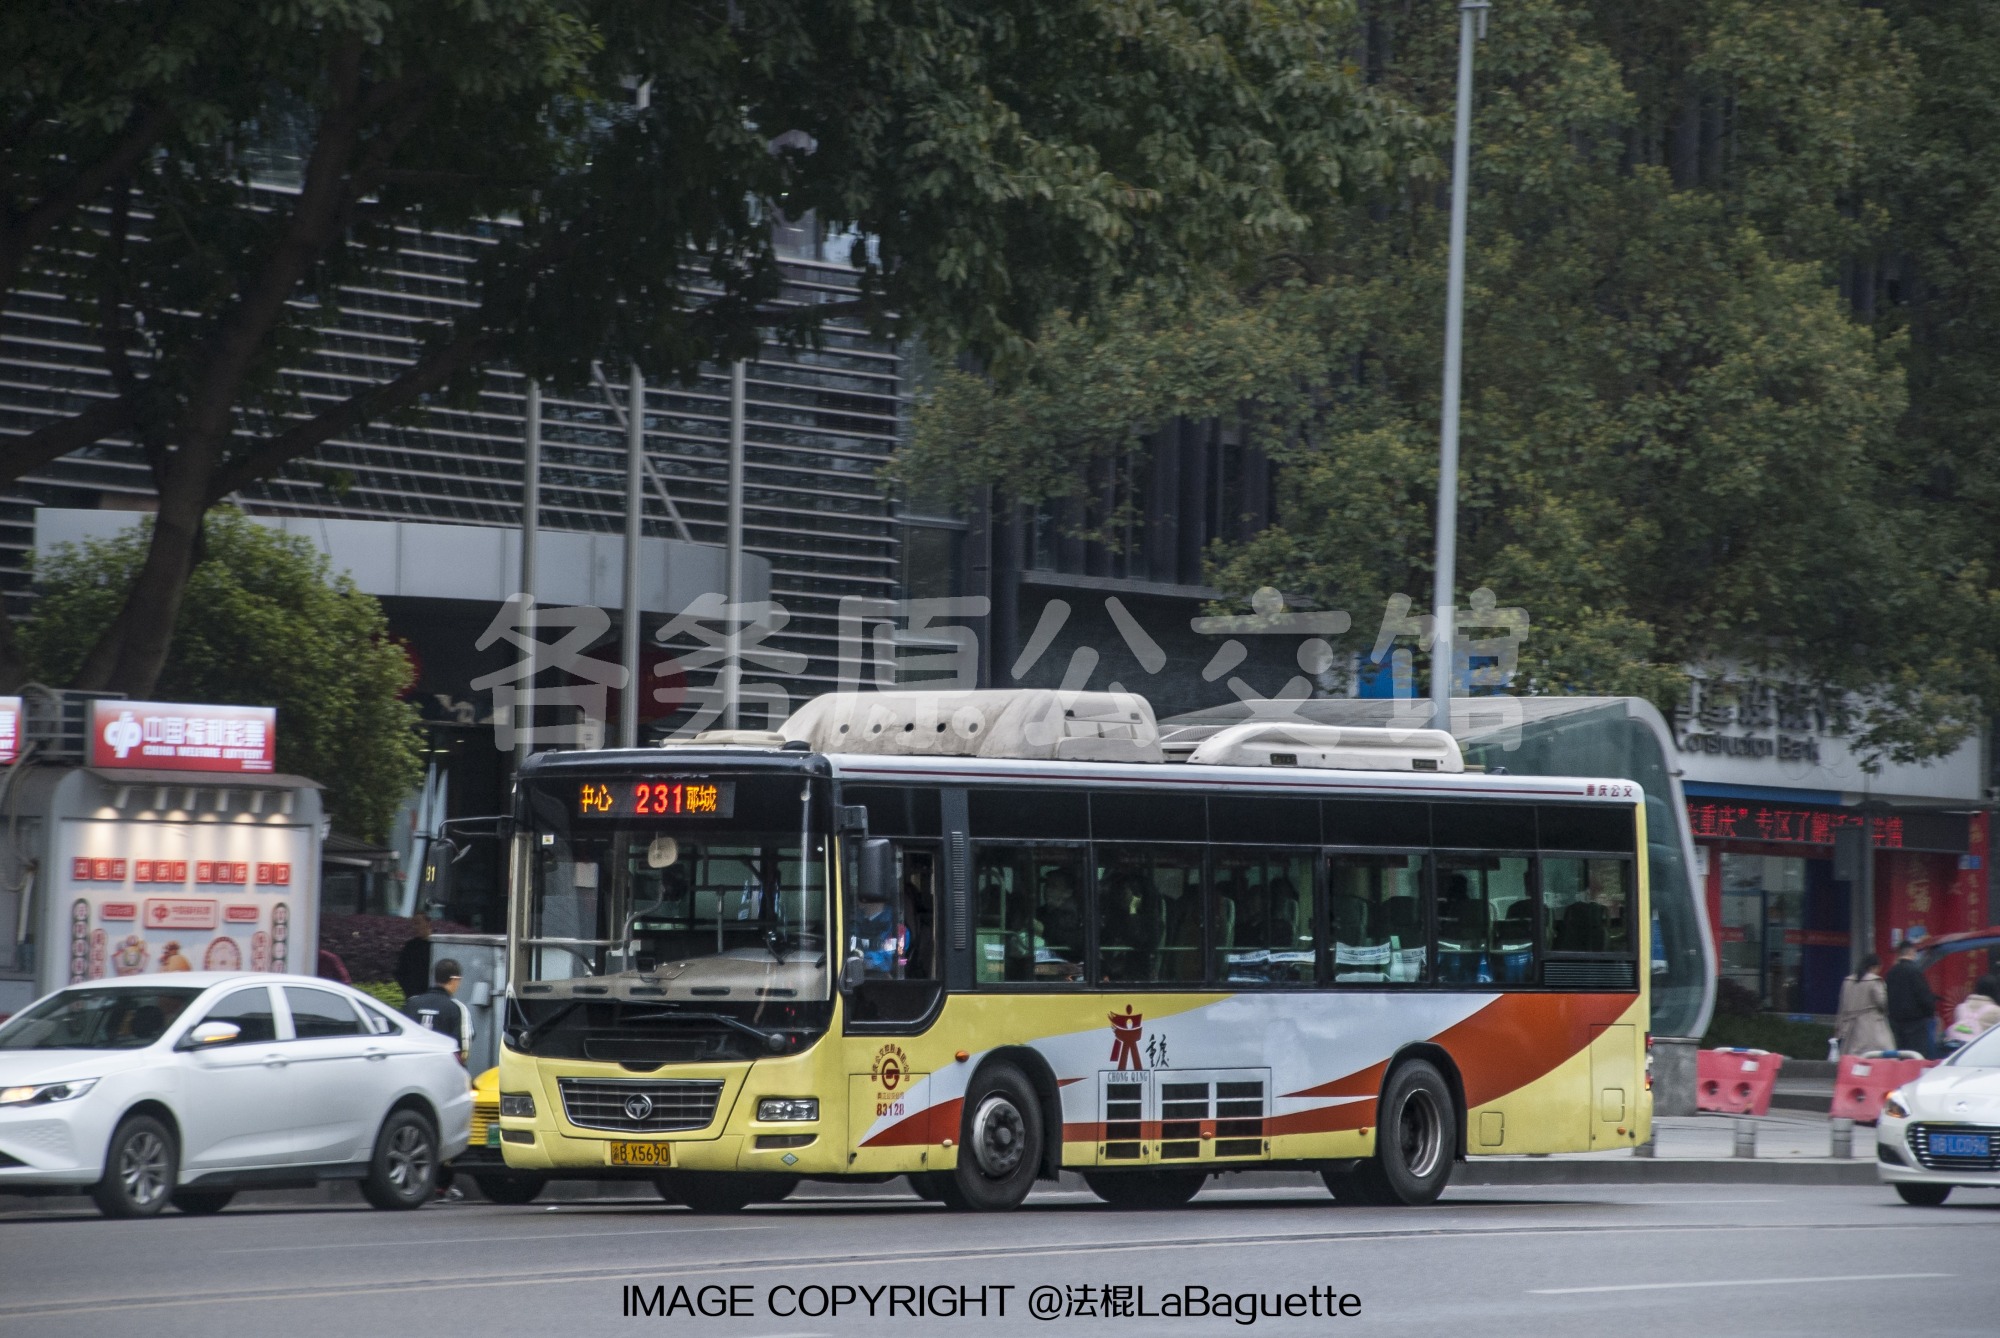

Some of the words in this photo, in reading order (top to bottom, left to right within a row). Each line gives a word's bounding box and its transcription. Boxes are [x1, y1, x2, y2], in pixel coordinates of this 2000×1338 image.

[143, 717, 265, 747] 中国福利彩票
[636, 784, 682, 813] 231
[1586, 784, 1632, 797] 重庆公交
[1108, 1072, 1128, 1082] CHONG
[1131, 1072, 1147, 1082] QING
